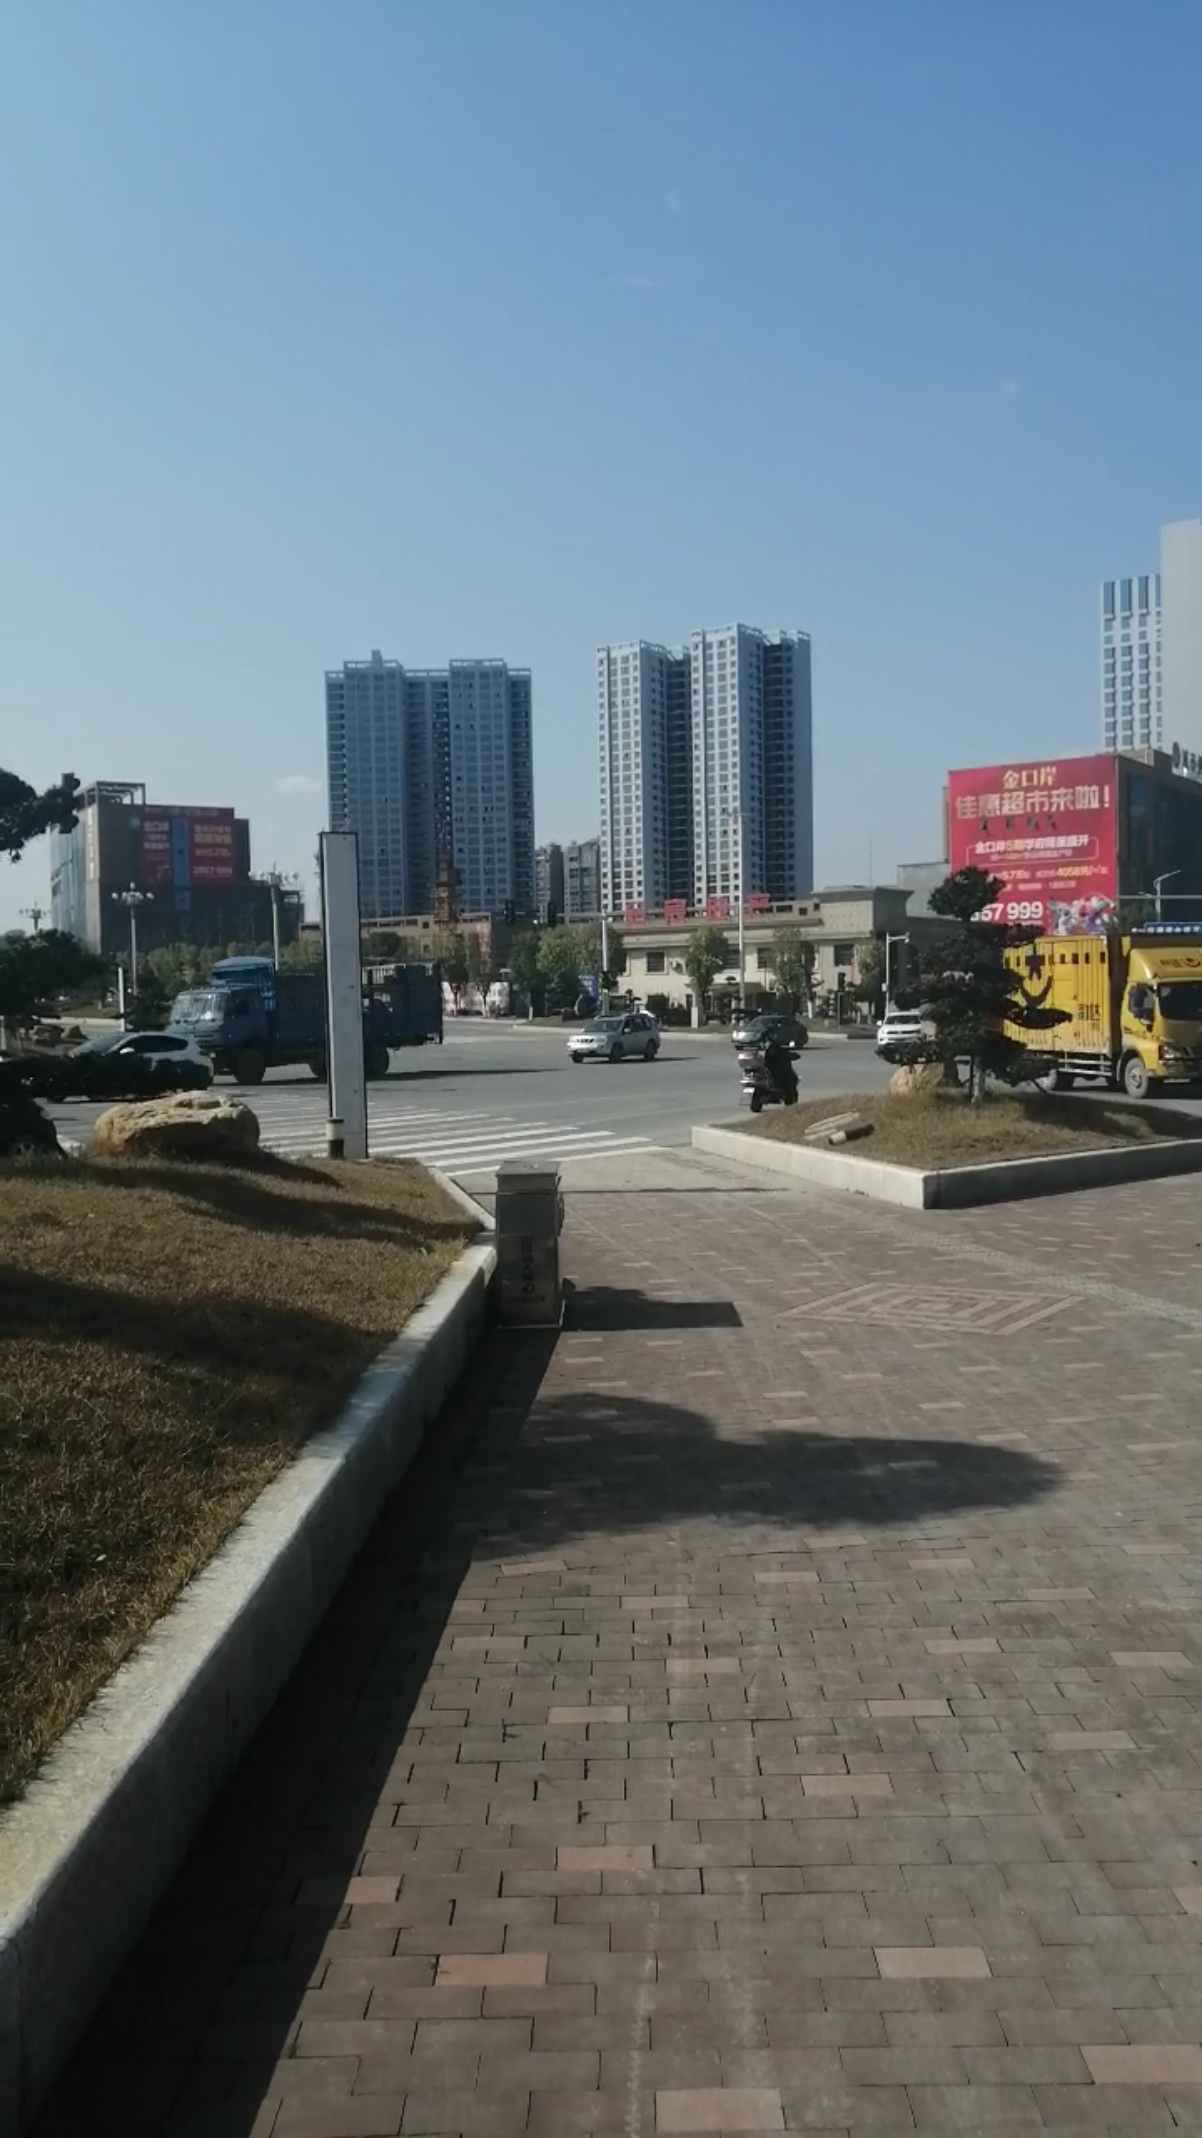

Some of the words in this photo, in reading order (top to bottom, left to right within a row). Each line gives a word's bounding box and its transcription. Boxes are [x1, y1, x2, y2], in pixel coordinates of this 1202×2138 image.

[1003, 766, 1057, 789] 金口岸
[1007, 902, 1043, 920] 999
